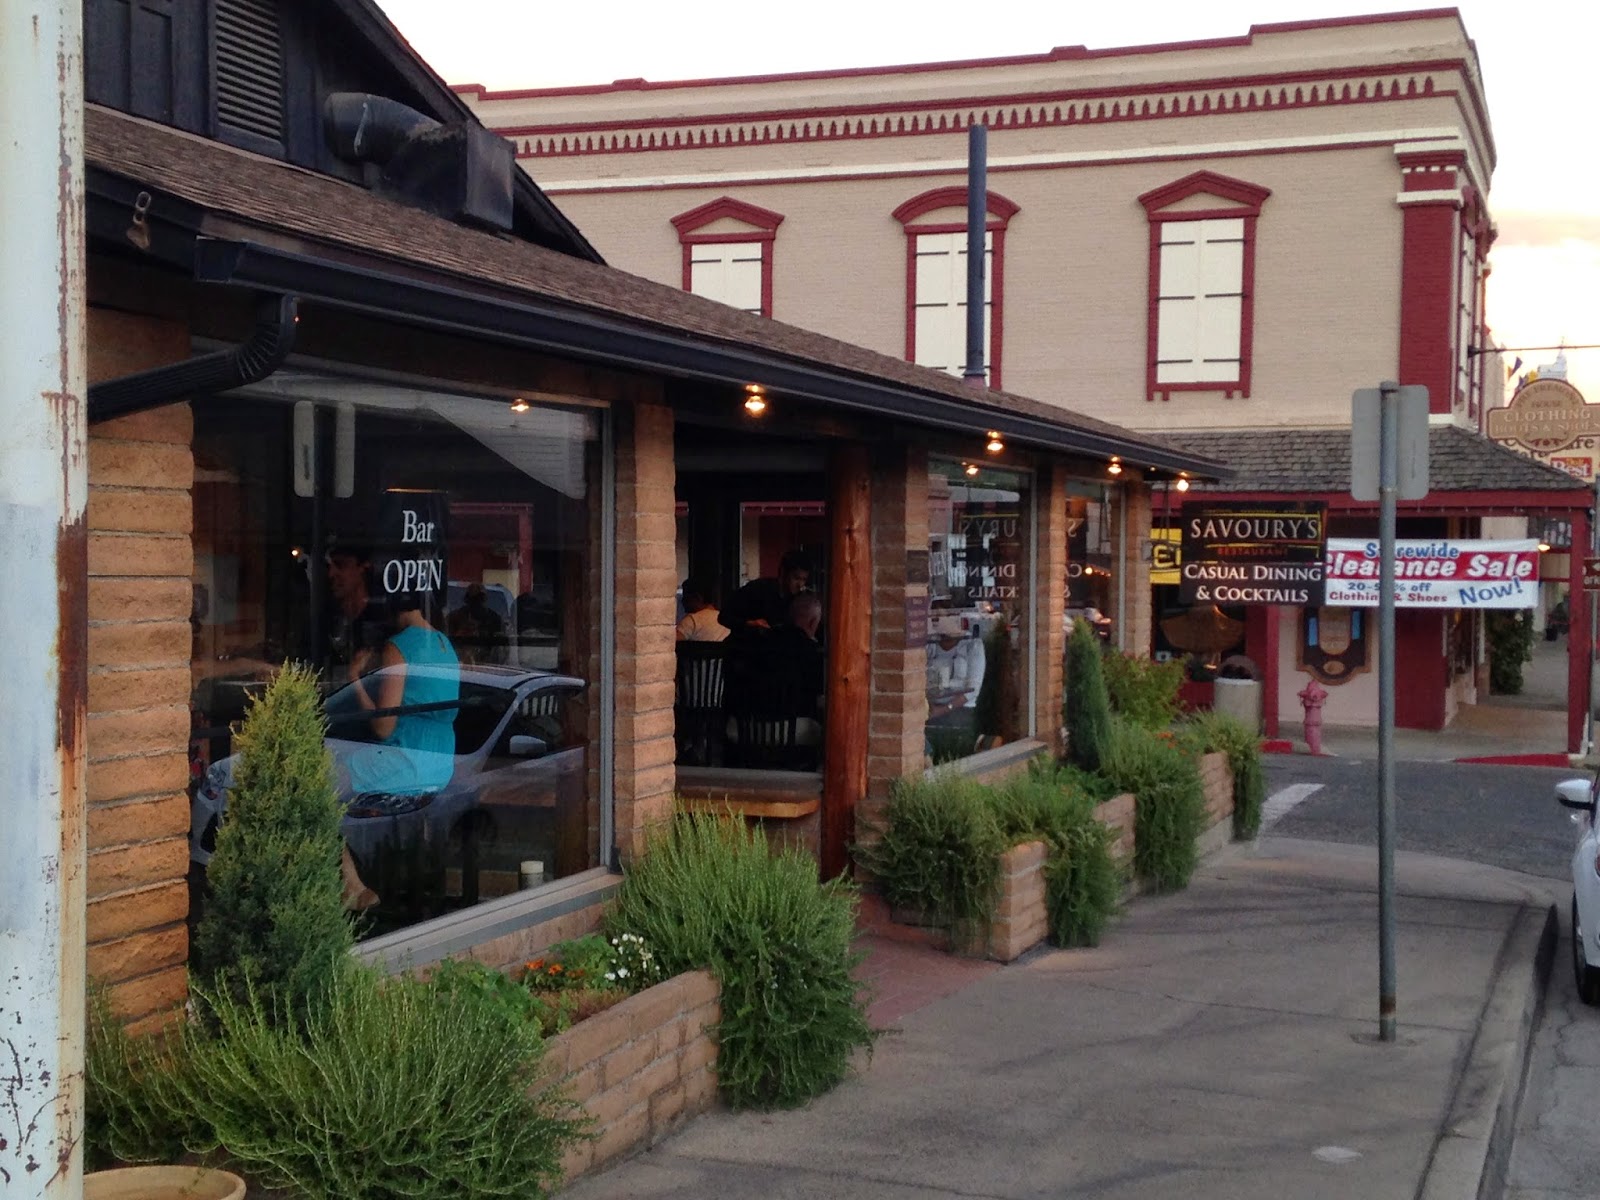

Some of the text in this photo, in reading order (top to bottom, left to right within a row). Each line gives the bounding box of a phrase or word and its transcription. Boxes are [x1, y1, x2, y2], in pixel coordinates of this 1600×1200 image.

[1503, 408, 1591, 423] CLOTHING
[401, 509, 435, 543] Bar
[1190, 517, 1318, 539] SAVOURY'S
[1366, 542, 1459, 558] Srewide
[1184, 563, 1322, 581] CASUAL DINING
[1466, 553, 1533, 577] Sale
[382, 559, 444, 594] OPEN
[1196, 585, 1309, 602] & COCKTAILS
[1410, 582, 1432, 591] off
[1329, 591, 1379, 601] Clothin
[1408, 593, 1448, 602] Shoes
